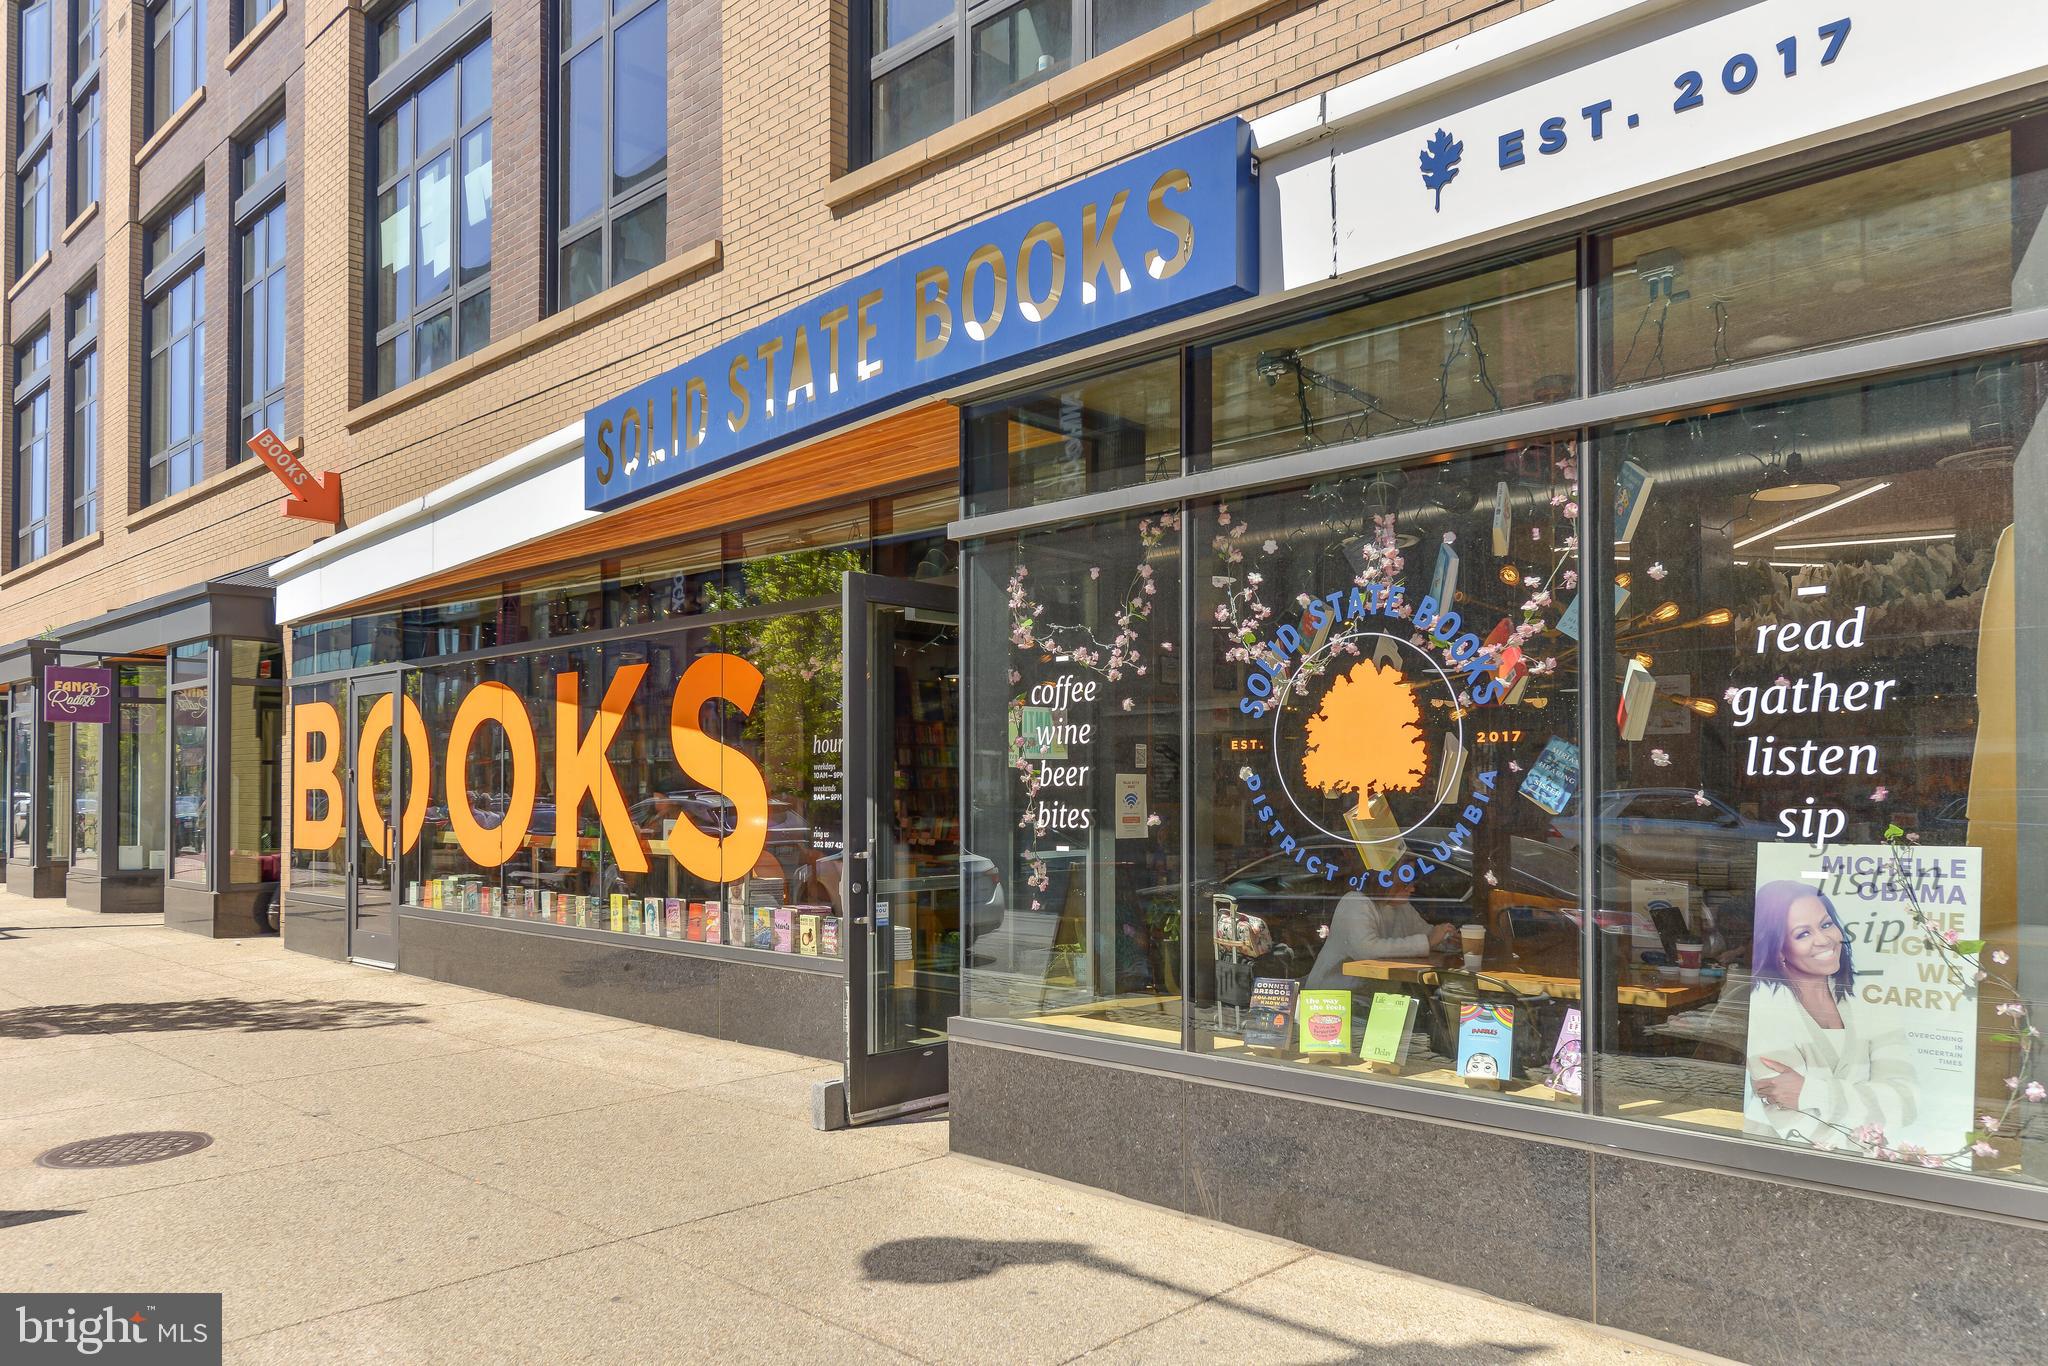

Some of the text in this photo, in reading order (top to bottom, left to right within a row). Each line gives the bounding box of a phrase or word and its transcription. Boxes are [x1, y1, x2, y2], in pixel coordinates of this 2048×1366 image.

[1499, 16, 1852, 171] EST. 2017
[595, 168, 1195, 486] SOLID STATE BOOKS
[258, 434, 308, 486] BOOKS
[1756, 605, 1867, 654] read
[1239, 583, 1504, 719] SOLID STATE BOOKS
[54, 680, 98, 693] FANCY
[1031, 674, 1097, 712] coffee
[1731, 671, 1896, 727] gather
[1036, 717, 1091, 745] wine
[1231, 739, 1264, 751] EST.
[1476, 729, 1522, 744] 2017
[294, 652, 769, 883] BOOKS
[1746, 735, 1878, 776] listen
[1040, 759, 1089, 787] beer
[1037, 800, 1091, 830] bites
[1776, 796, 1846, 850] sip
[1246, 769, 1498, 890] DISTRICT of COLUMBIA
[1822, 855, 1967, 879] MICHELLE
[1857, 881, 1967, 906] OBAMA
[1876, 934, 1963, 961] LIG
[1257, 982, 1290, 990] CONNIE
[1917, 962, 1964, 986] WE
[1254, 988, 1291, 996] BRISCOE
[1862, 984, 1966, 1012] CARRY
[1907, 1031, 1964, 1043] OVERCOMING
[1917, 1049, 1964, 1060] UNCERTAIN
[1938, 1058, 1963, 1067] TIMES
